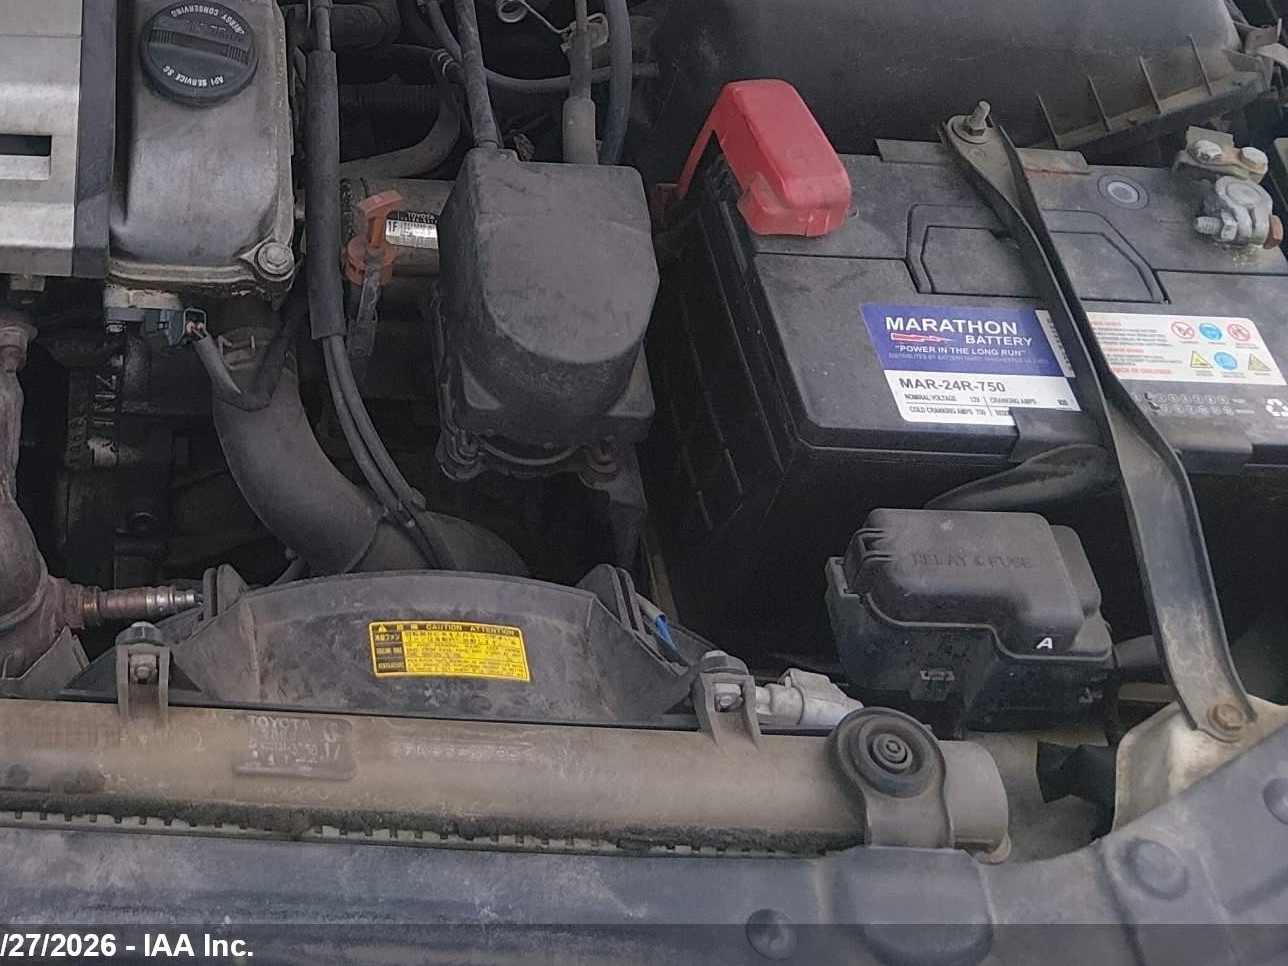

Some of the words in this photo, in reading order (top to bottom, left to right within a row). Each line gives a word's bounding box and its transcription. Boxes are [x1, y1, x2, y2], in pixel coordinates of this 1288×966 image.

[170, 4, 220, 18] CONSERVING
[175, 73, 208, 87] SERVICE
[210, 75, 224, 86] API
[407, 212, 435, 220] TOYOTA
[387, 221, 399, 233] 1F
[885, 316, 1018, 335] MARATHON
[965, 335, 1033, 347] BATTERY
[938, 346, 948, 354] IN
[949, 347, 970, 355] THE
[971, 348, 1000, 356] LONG
[898, 377, 1006, 393] MAR-24R-750
[912, 553, 969, 568] RELAY
[987, 555, 1034, 570] FUSE
[425, 624, 463, 632] CAUTION
[469, 625, 515, 636] ATTENTION
[1036, 637, 1053, 650] A
[247, 714, 312, 731] TOYOTA
